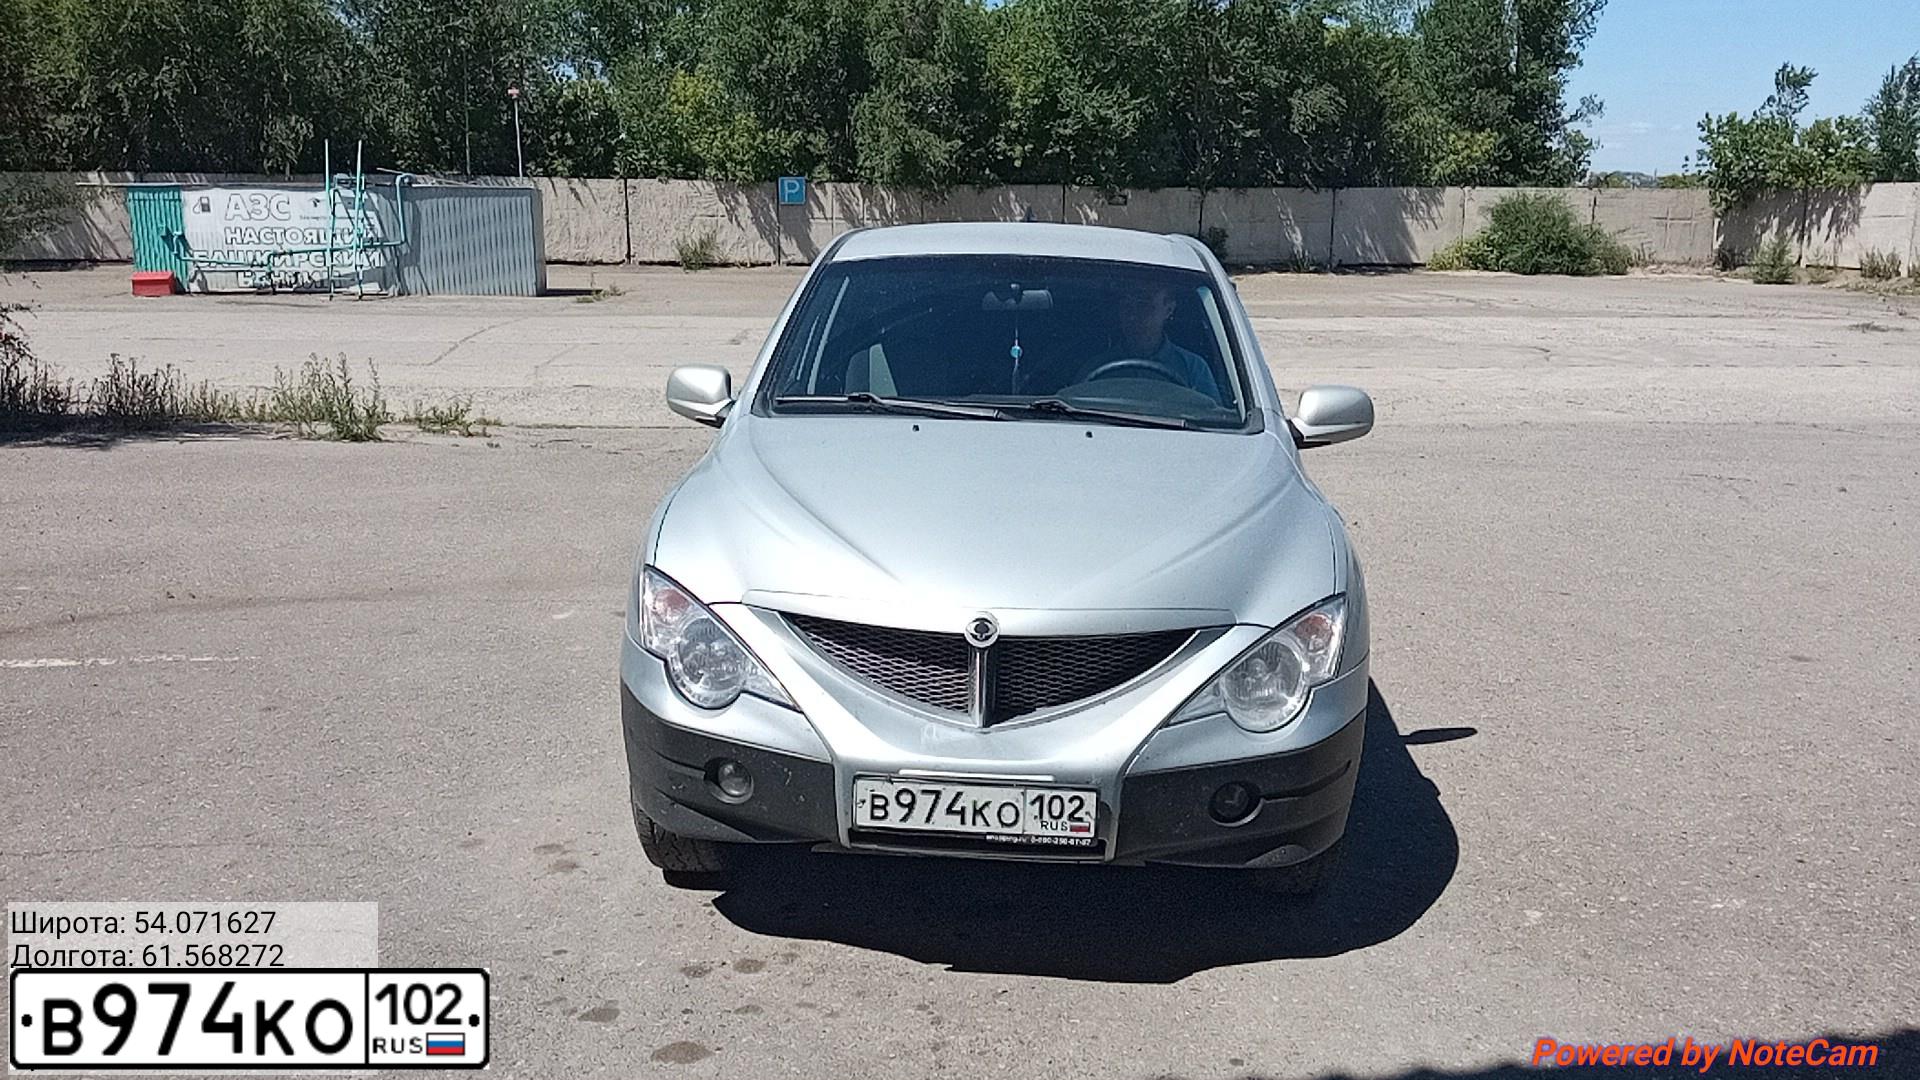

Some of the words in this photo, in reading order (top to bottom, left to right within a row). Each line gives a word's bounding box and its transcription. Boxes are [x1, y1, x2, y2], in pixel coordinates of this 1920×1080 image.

[784, 180, 800, 202] P
[225, 193, 290, 221] АЗС
[1029, 795, 1086, 822] 102
[1041, 821, 1068, 831] RUS
